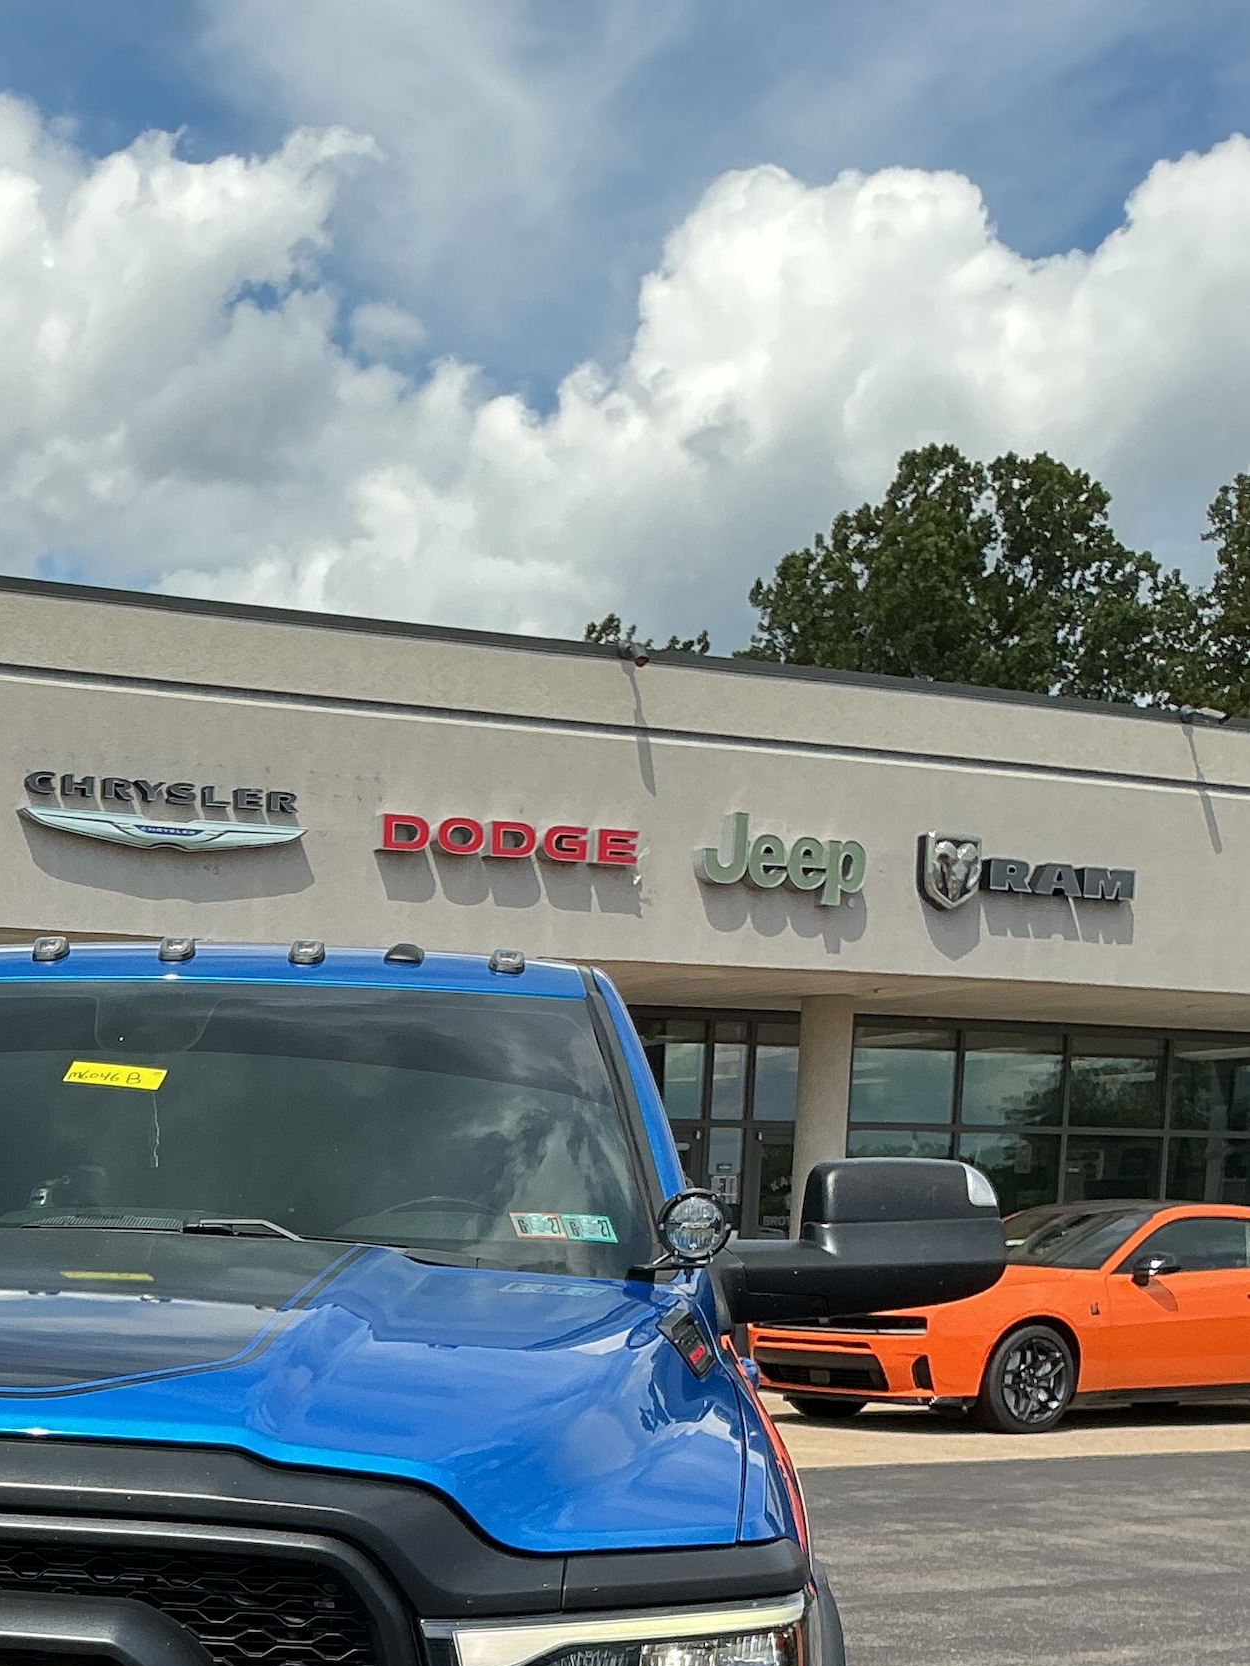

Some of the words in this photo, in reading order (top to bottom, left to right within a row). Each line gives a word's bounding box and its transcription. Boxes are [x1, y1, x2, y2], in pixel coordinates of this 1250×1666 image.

[24, 770, 298, 814] CHRYSLER
[140, 826, 196, 835] CHRYSLER
[377, 812, 639, 866] DODGE
[694, 811, 867, 906] Jeep
[983, 857, 1136, 901] RAM
